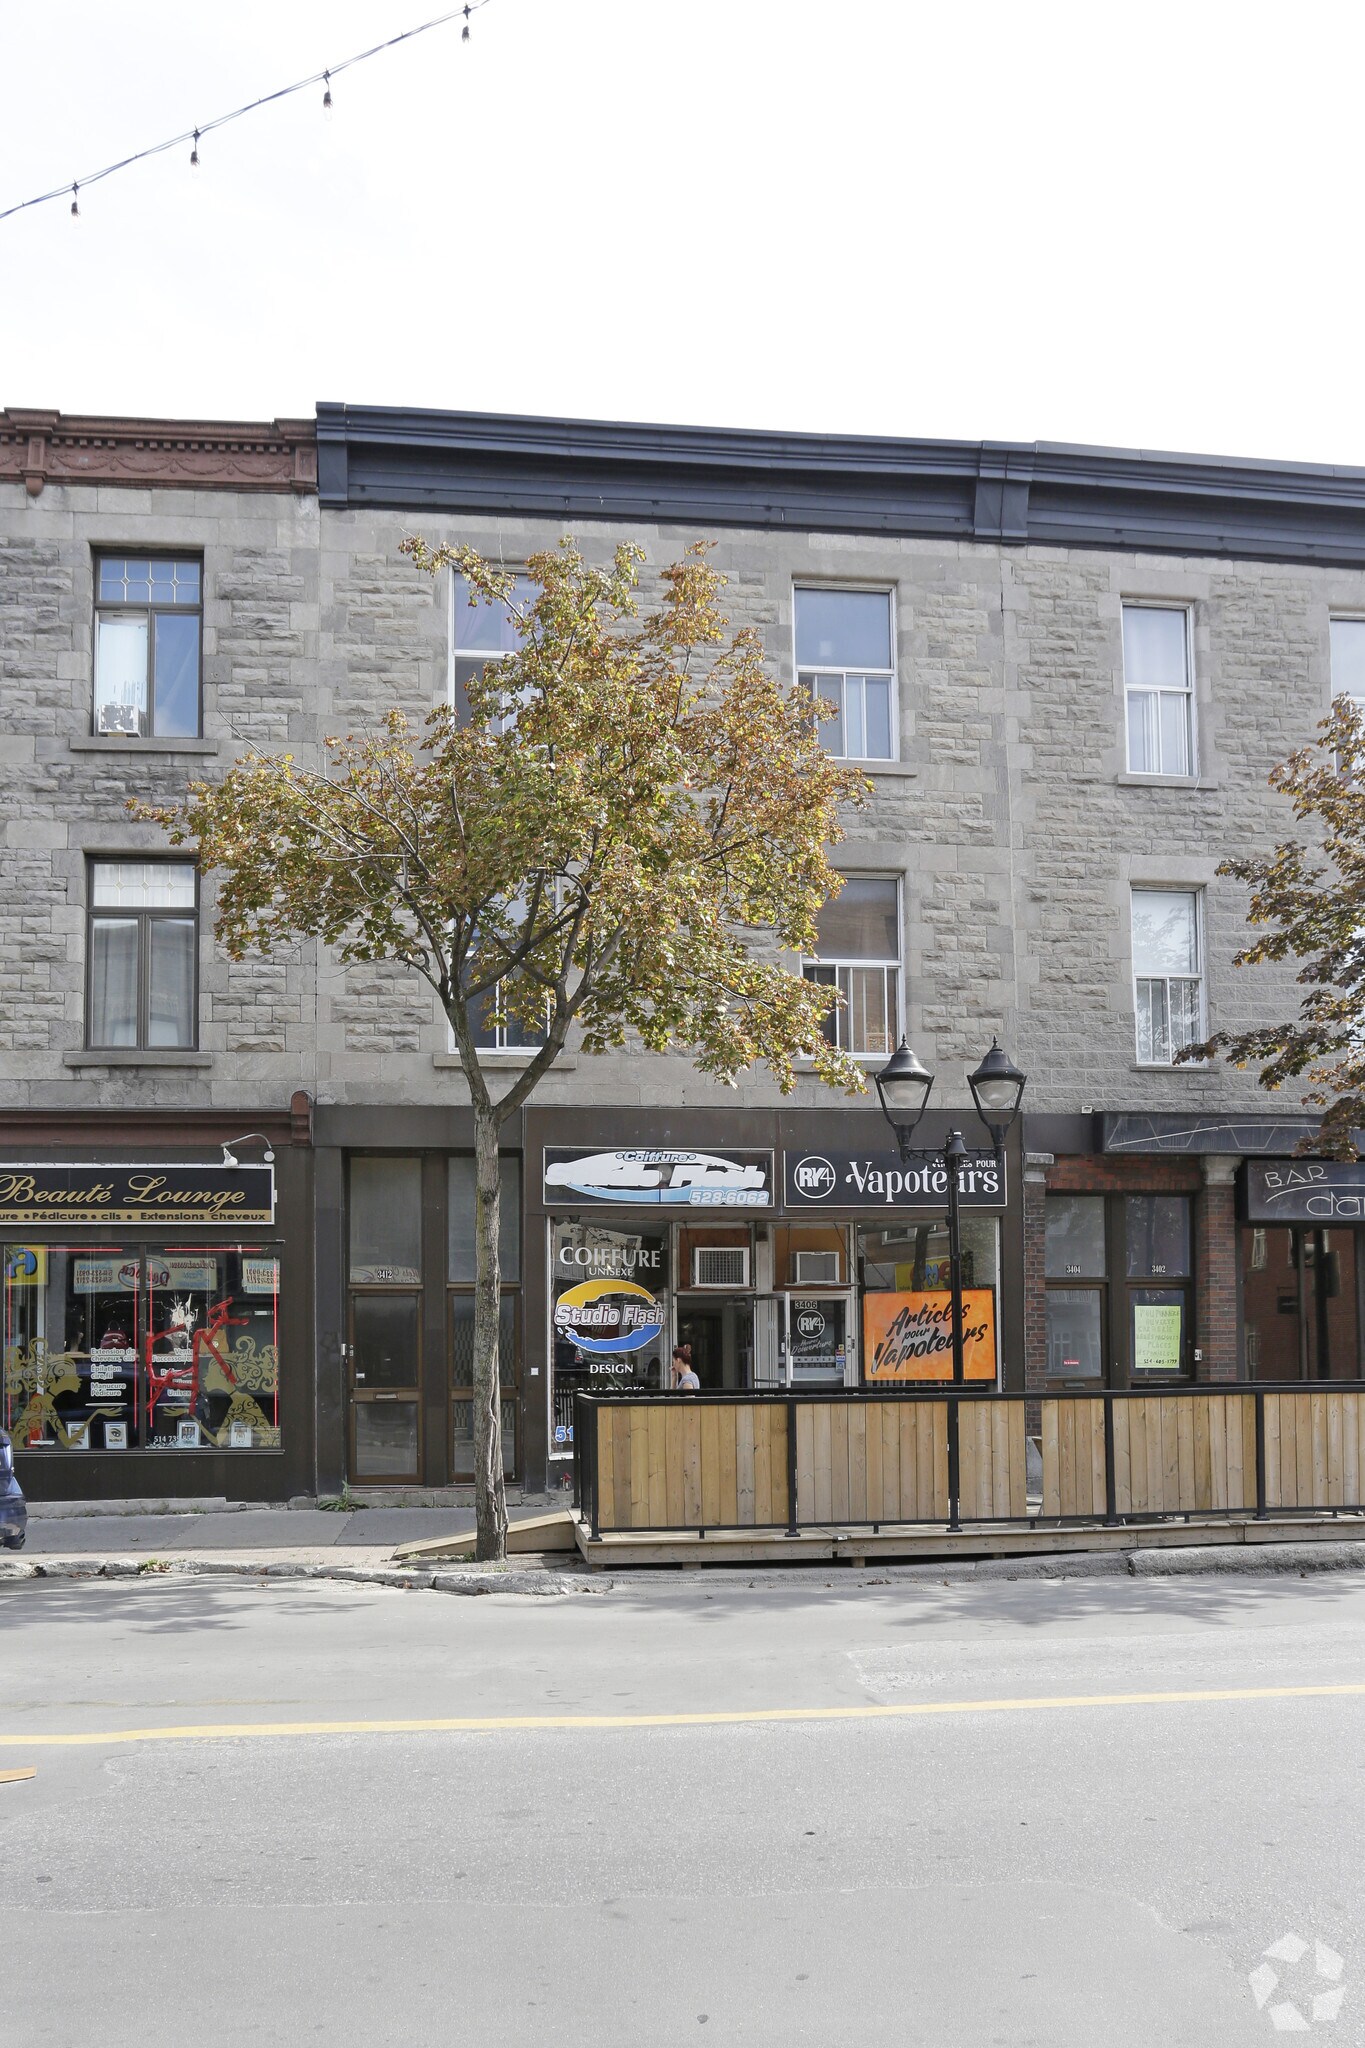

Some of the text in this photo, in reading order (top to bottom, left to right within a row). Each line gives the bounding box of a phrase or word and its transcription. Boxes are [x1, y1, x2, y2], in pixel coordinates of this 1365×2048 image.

[623, 1151, 691, 1163] Coiffure
[975, 1159, 997, 1168] POUR
[798, 1166, 836, 1188] RY4
[1264, 1165, 1328, 1188] BAR
[0, 1174, 115, 1203] Beauté
[123, 1174, 246, 1214] Lounge
[690, 1191, 769, 1205] 528-6062
[32, 1211, 89, 1221] Pédicure
[100, 1212, 122, 1221] cils
[140, 1212, 205, 1221] Extensions
[210, 1212, 266, 1221] cheveux
[559, 1246, 661, 1268] COIFFURE
[588, 1267, 633, 1277] UNISEXE
[1066, 1265, 1081, 1274] 3404
[1151, 1265, 1166, 1273] 3402
[377, 1270, 394, 1279] 3412
[795, 1300, 817, 1310] 3406
[554, 1303, 666, 1326] Studio Flash
[800, 1316, 824, 1331] RY4
[902, 1328, 931, 1343] pour
[91, 1347, 125, 1355] Extension
[91, 1364, 122, 1373] Épilation
[589, 1364, 634, 1374] DESIGN
[91, 1382, 127, 1390] Manucure
[91, 1388, 122, 1397] Pédicure
